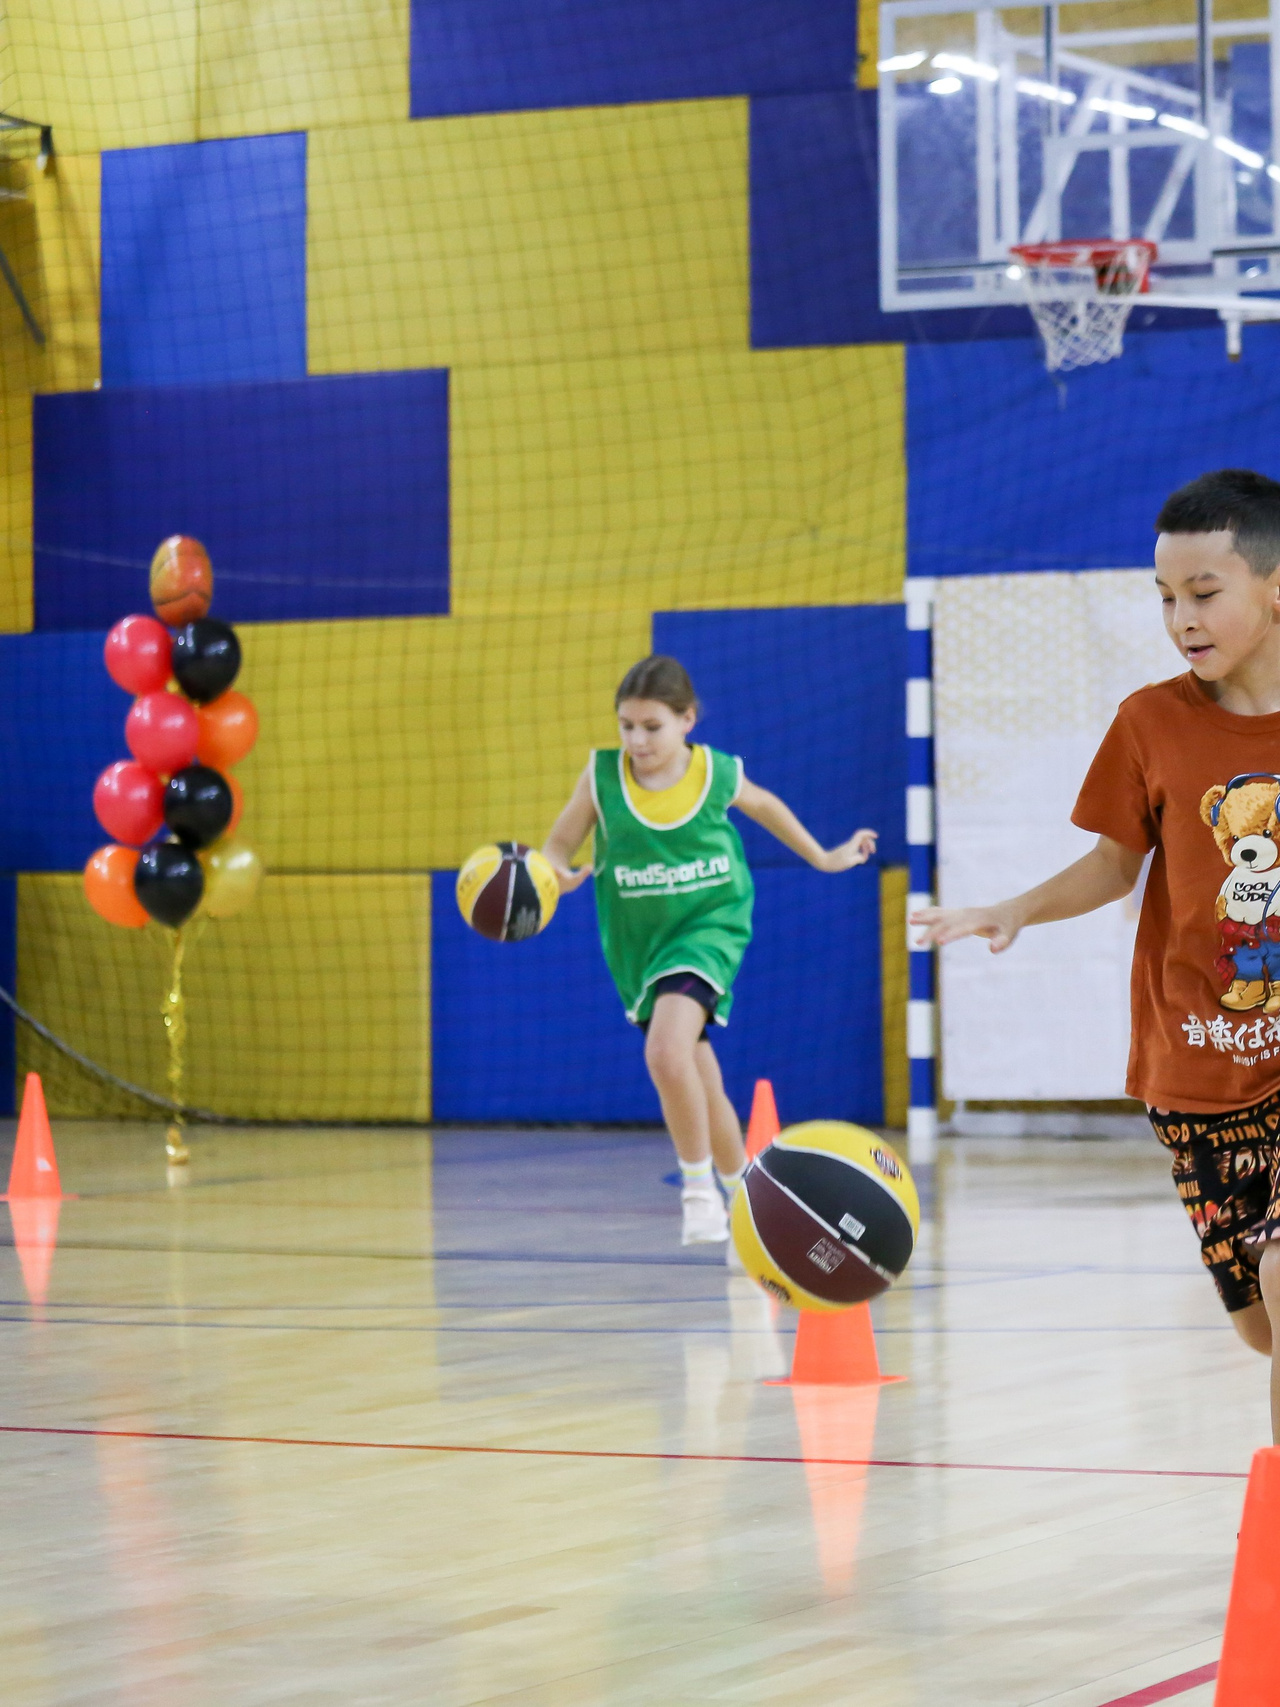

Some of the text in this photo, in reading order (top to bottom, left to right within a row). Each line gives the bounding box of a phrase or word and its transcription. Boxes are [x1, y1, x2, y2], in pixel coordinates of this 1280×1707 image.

[613, 854, 730, 888] FindSport.ru
[1234, 881, 1272, 892] COOL
[1232, 891, 1270, 902] DUDE
[1260, 1049, 1271, 1060] IS
